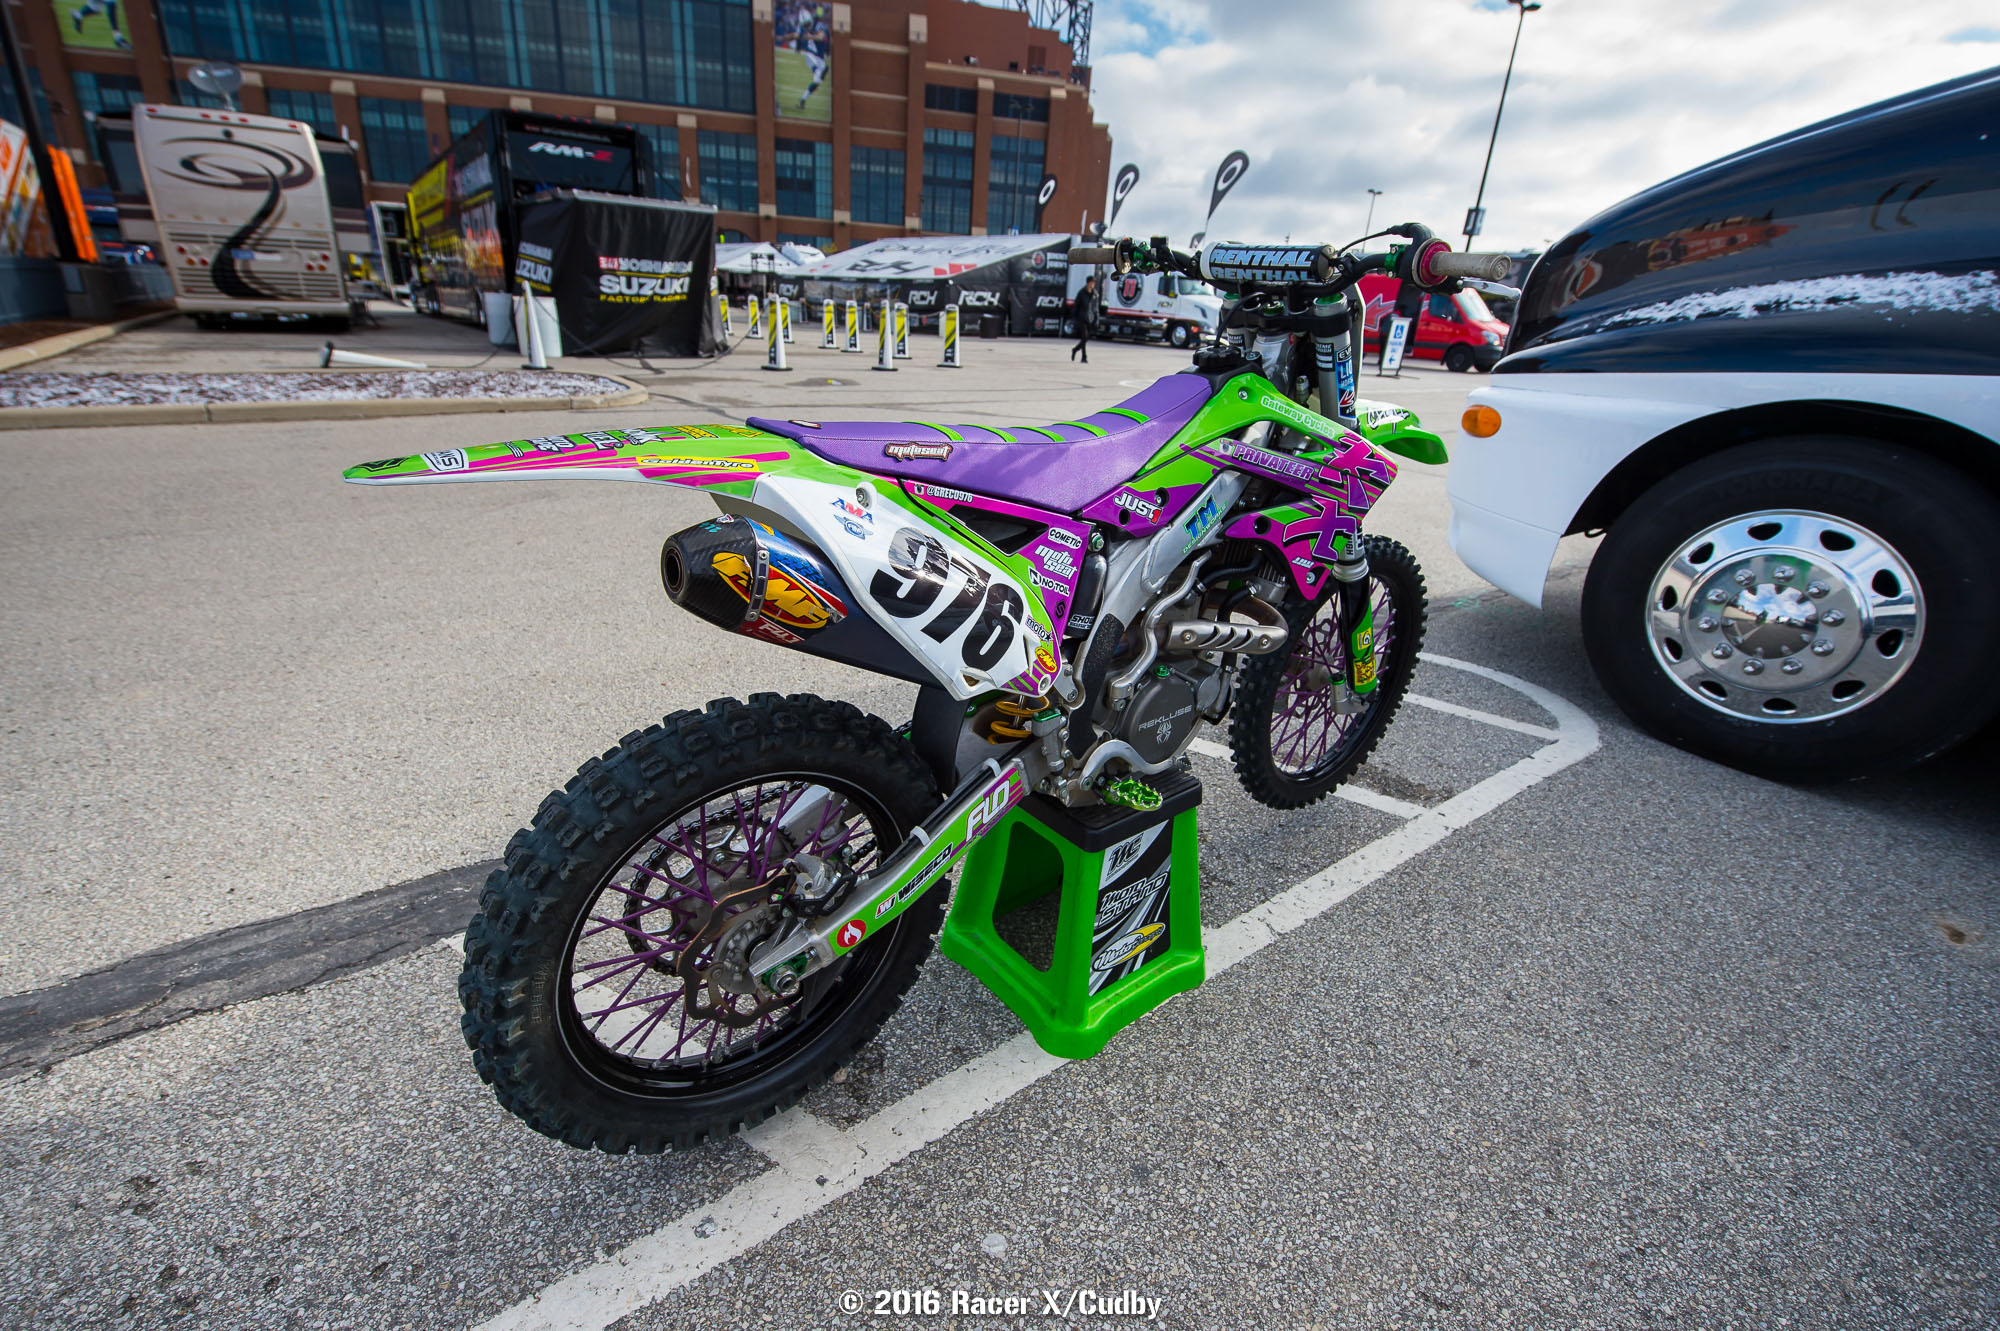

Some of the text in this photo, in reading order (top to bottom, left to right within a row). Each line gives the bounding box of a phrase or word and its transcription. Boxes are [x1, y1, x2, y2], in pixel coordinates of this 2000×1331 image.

[528, 141, 613, 162] RM-Z
[1210, 249, 1313, 267] RENTHAL
[599, 274, 690, 296] SUZUKI
[1211, 267, 1315, 281] RENTHAL
[908, 290, 938, 306] RCH
[958, 290, 1001, 306] RCH
[1036, 296, 1064, 308] RCH
[1261, 396, 1303, 423] Gateway
[1303, 412, 1335, 438] Cycles
[888, 443, 951, 460] motoseat
[1233, 443, 1314, 482] PRIVATEER
[926, 485, 973, 503] @GRECO976
[831, 497, 873, 524] AMA
[1114, 491, 1163, 525] JUST1
[1184, 494, 1218, 540] TM
[1049, 528, 1081, 548] COMETIC
[1034, 545, 1073, 566] moto
[1043, 560, 1077, 580] seat
[712, 552, 831, 623] FMF
[1042, 577, 1054, 589] NO
[1054, 580, 1070, 596] TOIL
[870, 527, 1024, 672] 976
[1138, 704, 1192, 732] REKLUSE
[966, 780, 1010, 843] FLO
[898, 842, 953, 902] WISECO
[1101, 877, 1147, 911] MOTO
[1101, 872, 1168, 923] STAND
